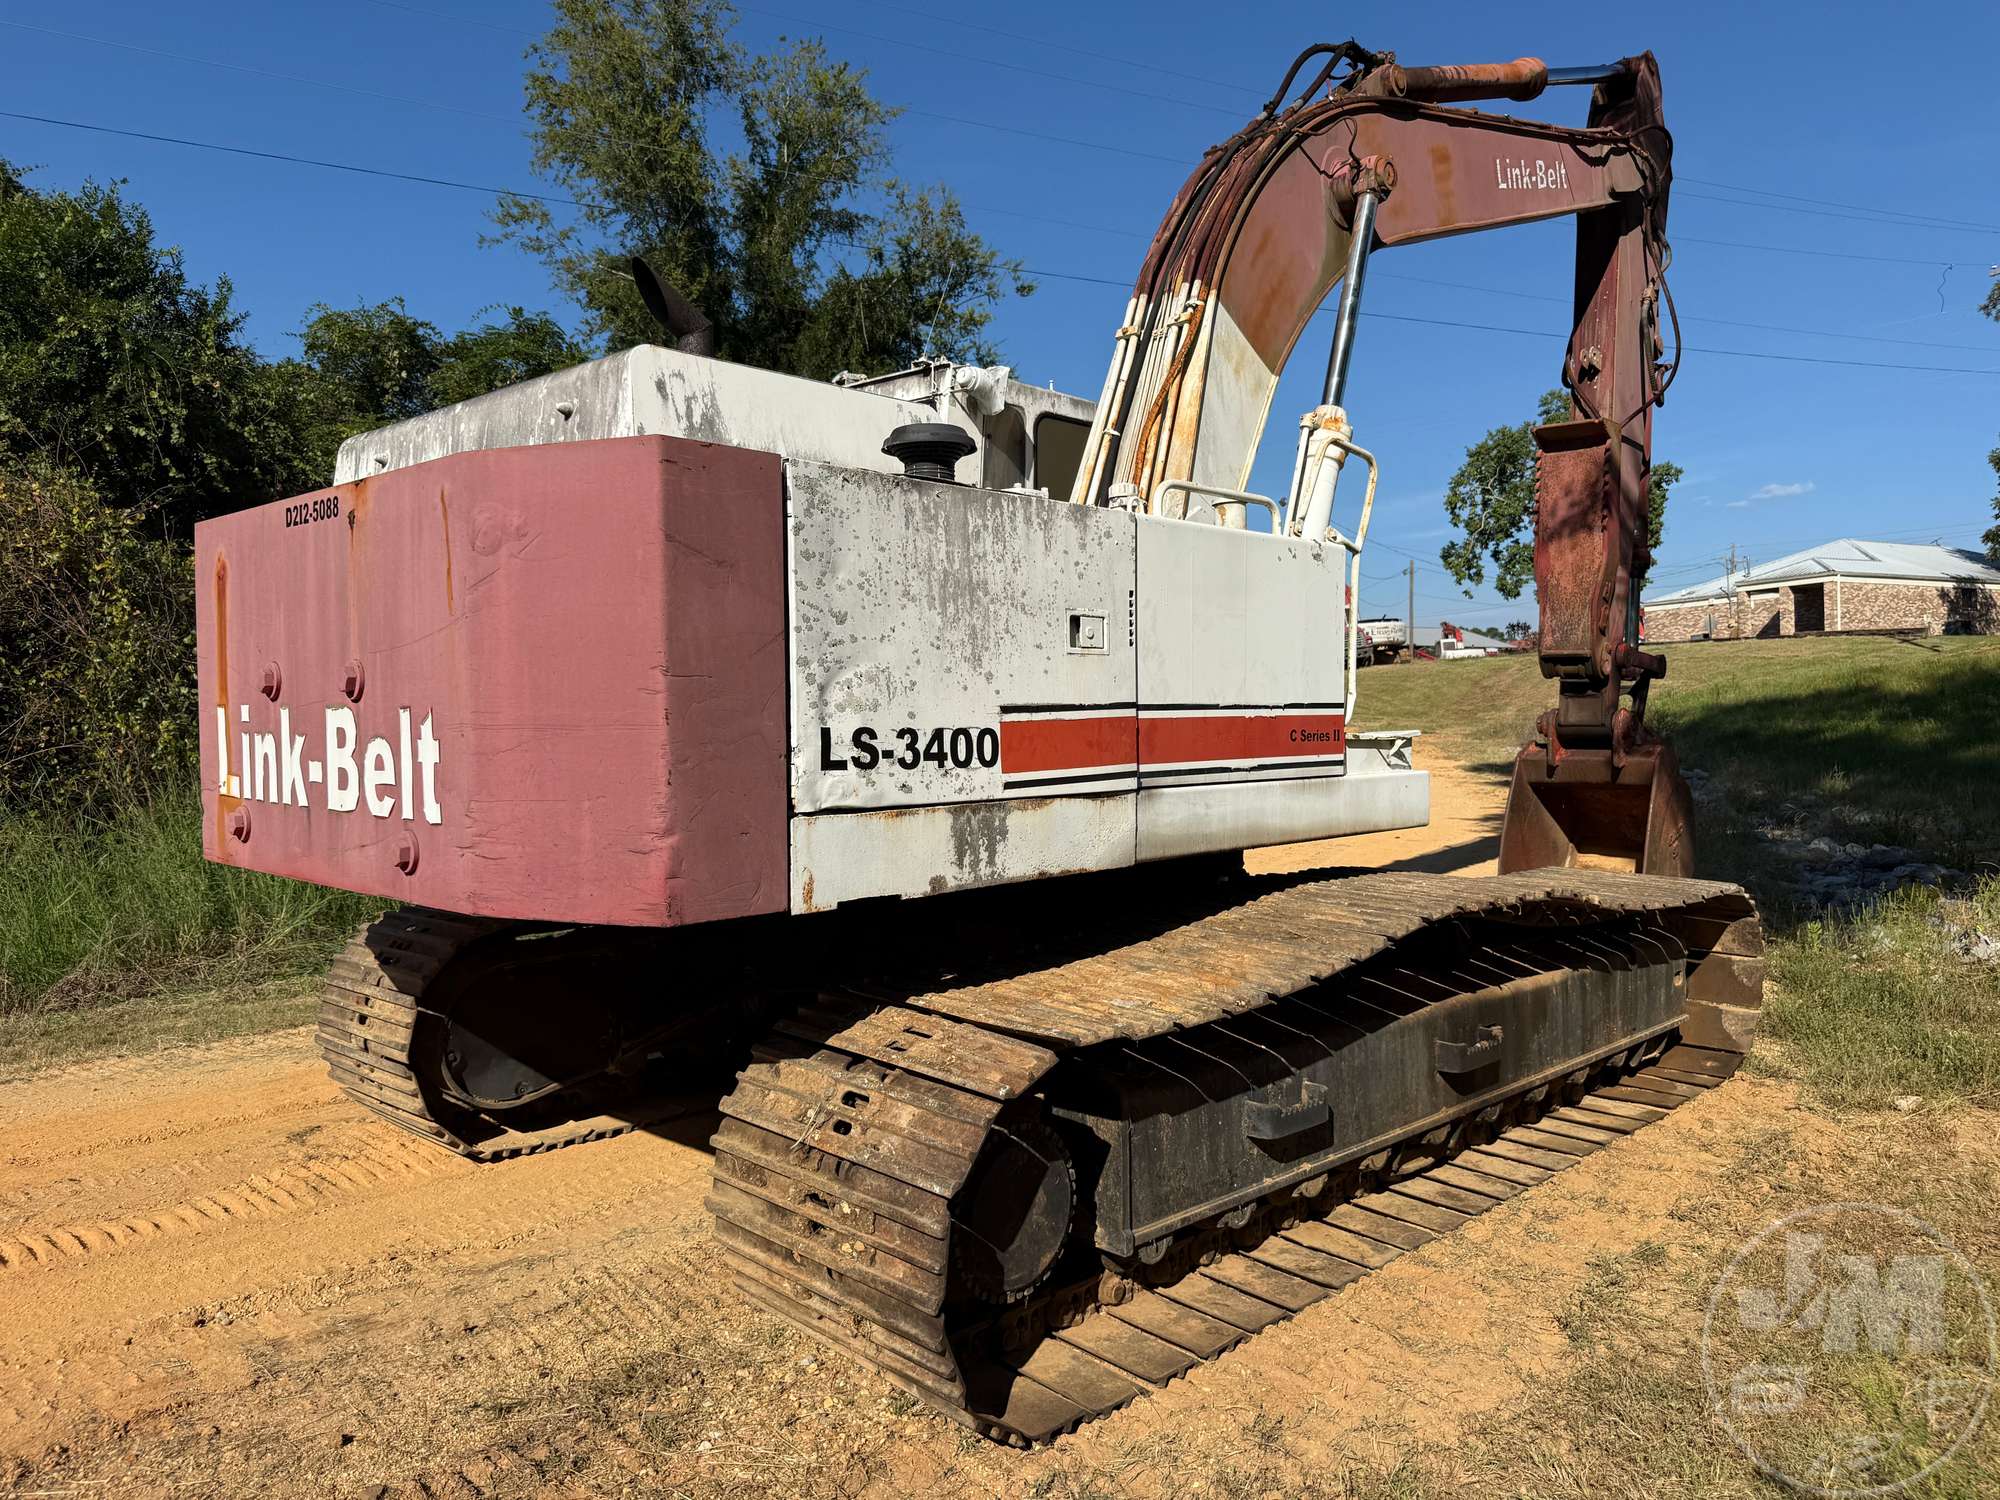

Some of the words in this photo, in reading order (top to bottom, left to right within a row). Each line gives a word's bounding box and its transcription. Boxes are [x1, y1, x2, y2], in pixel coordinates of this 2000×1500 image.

[1496, 158, 1568, 190] Link-Belt
[285, 495, 339, 528] D212-5088
[820, 726, 1000, 771] LS-3400
[1290, 729, 1297, 742] C
[1300, 729, 1330, 742] Series
[1333, 729, 1340, 742] II
[216, 703, 442, 825] Link-Belt
